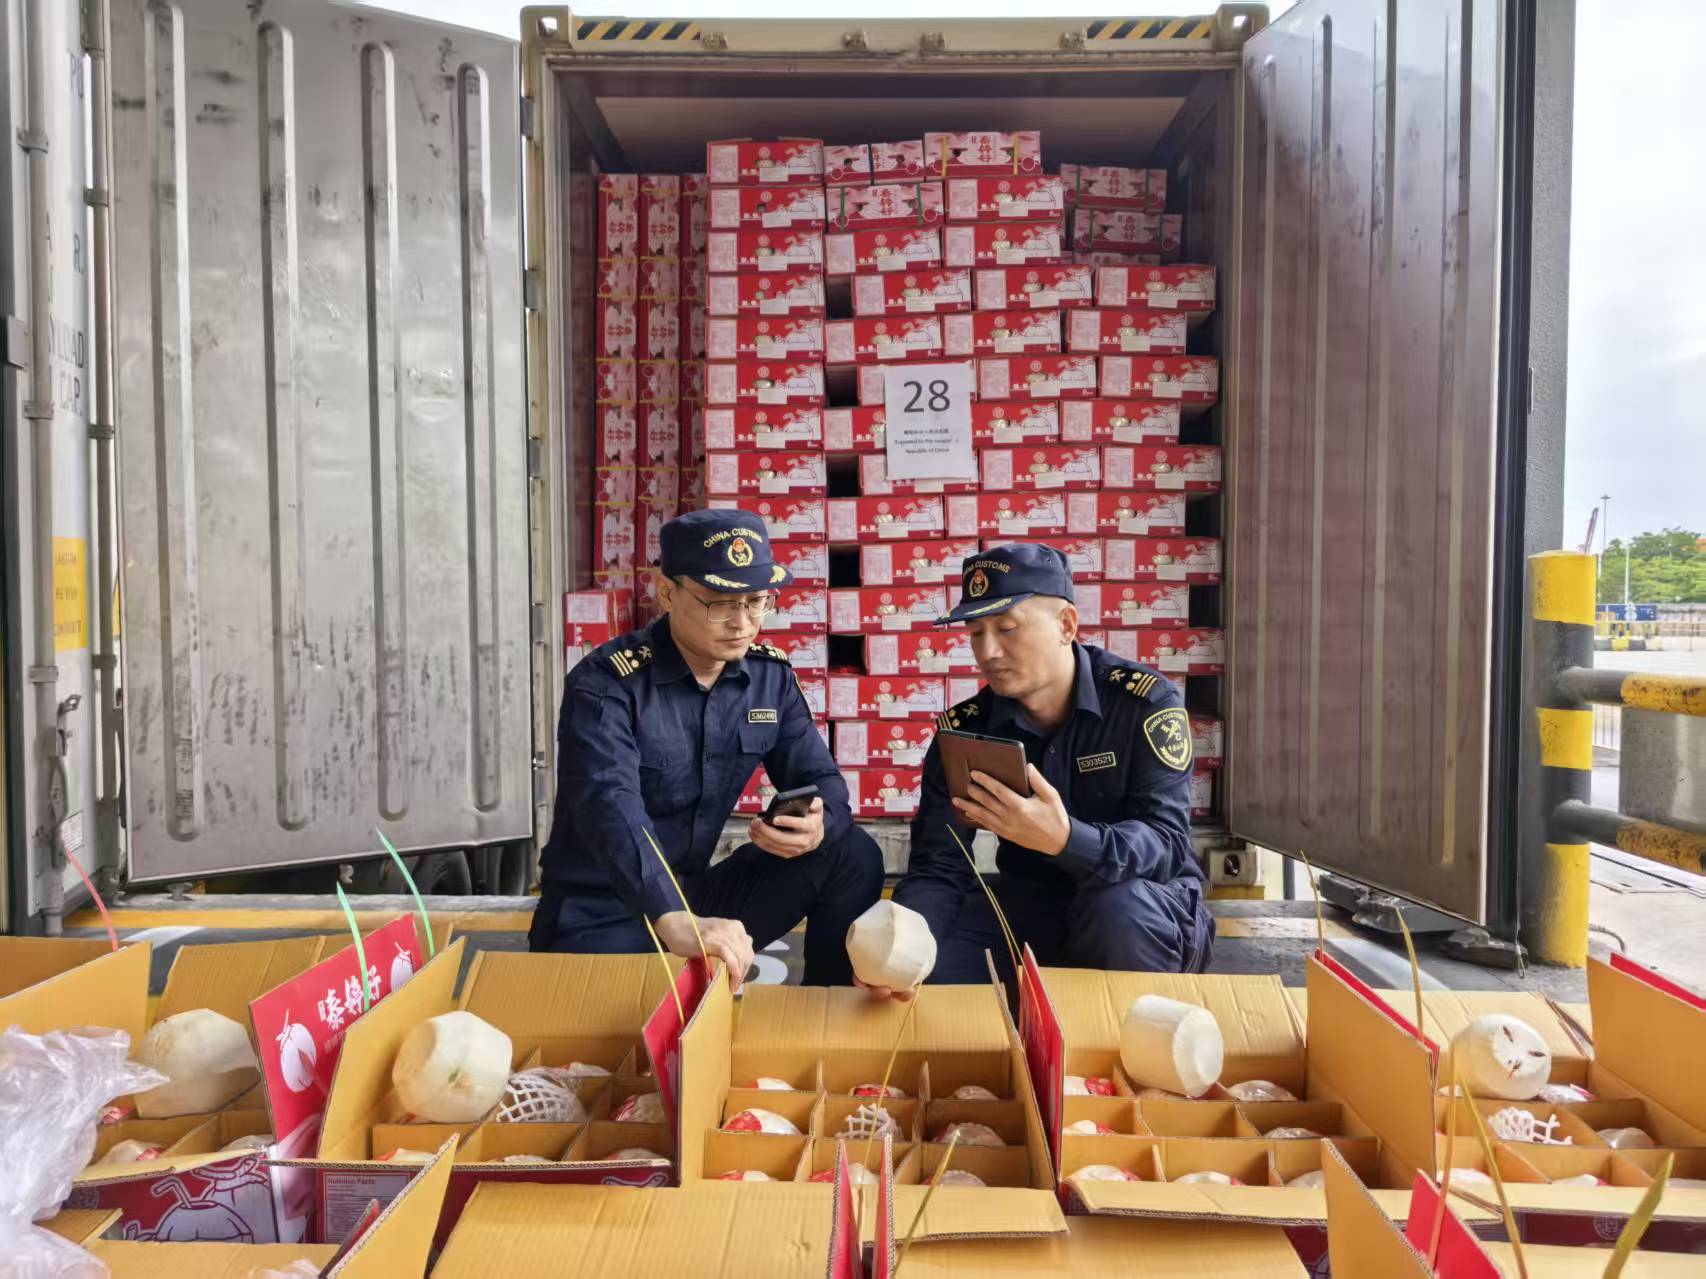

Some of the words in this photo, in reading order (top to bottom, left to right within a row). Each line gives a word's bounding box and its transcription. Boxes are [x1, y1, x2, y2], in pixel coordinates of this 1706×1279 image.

[904, 380, 950, 413] 28
[703, 531, 731, 548] CHINA
[974, 560, 1010, 573] CUSTOMS
